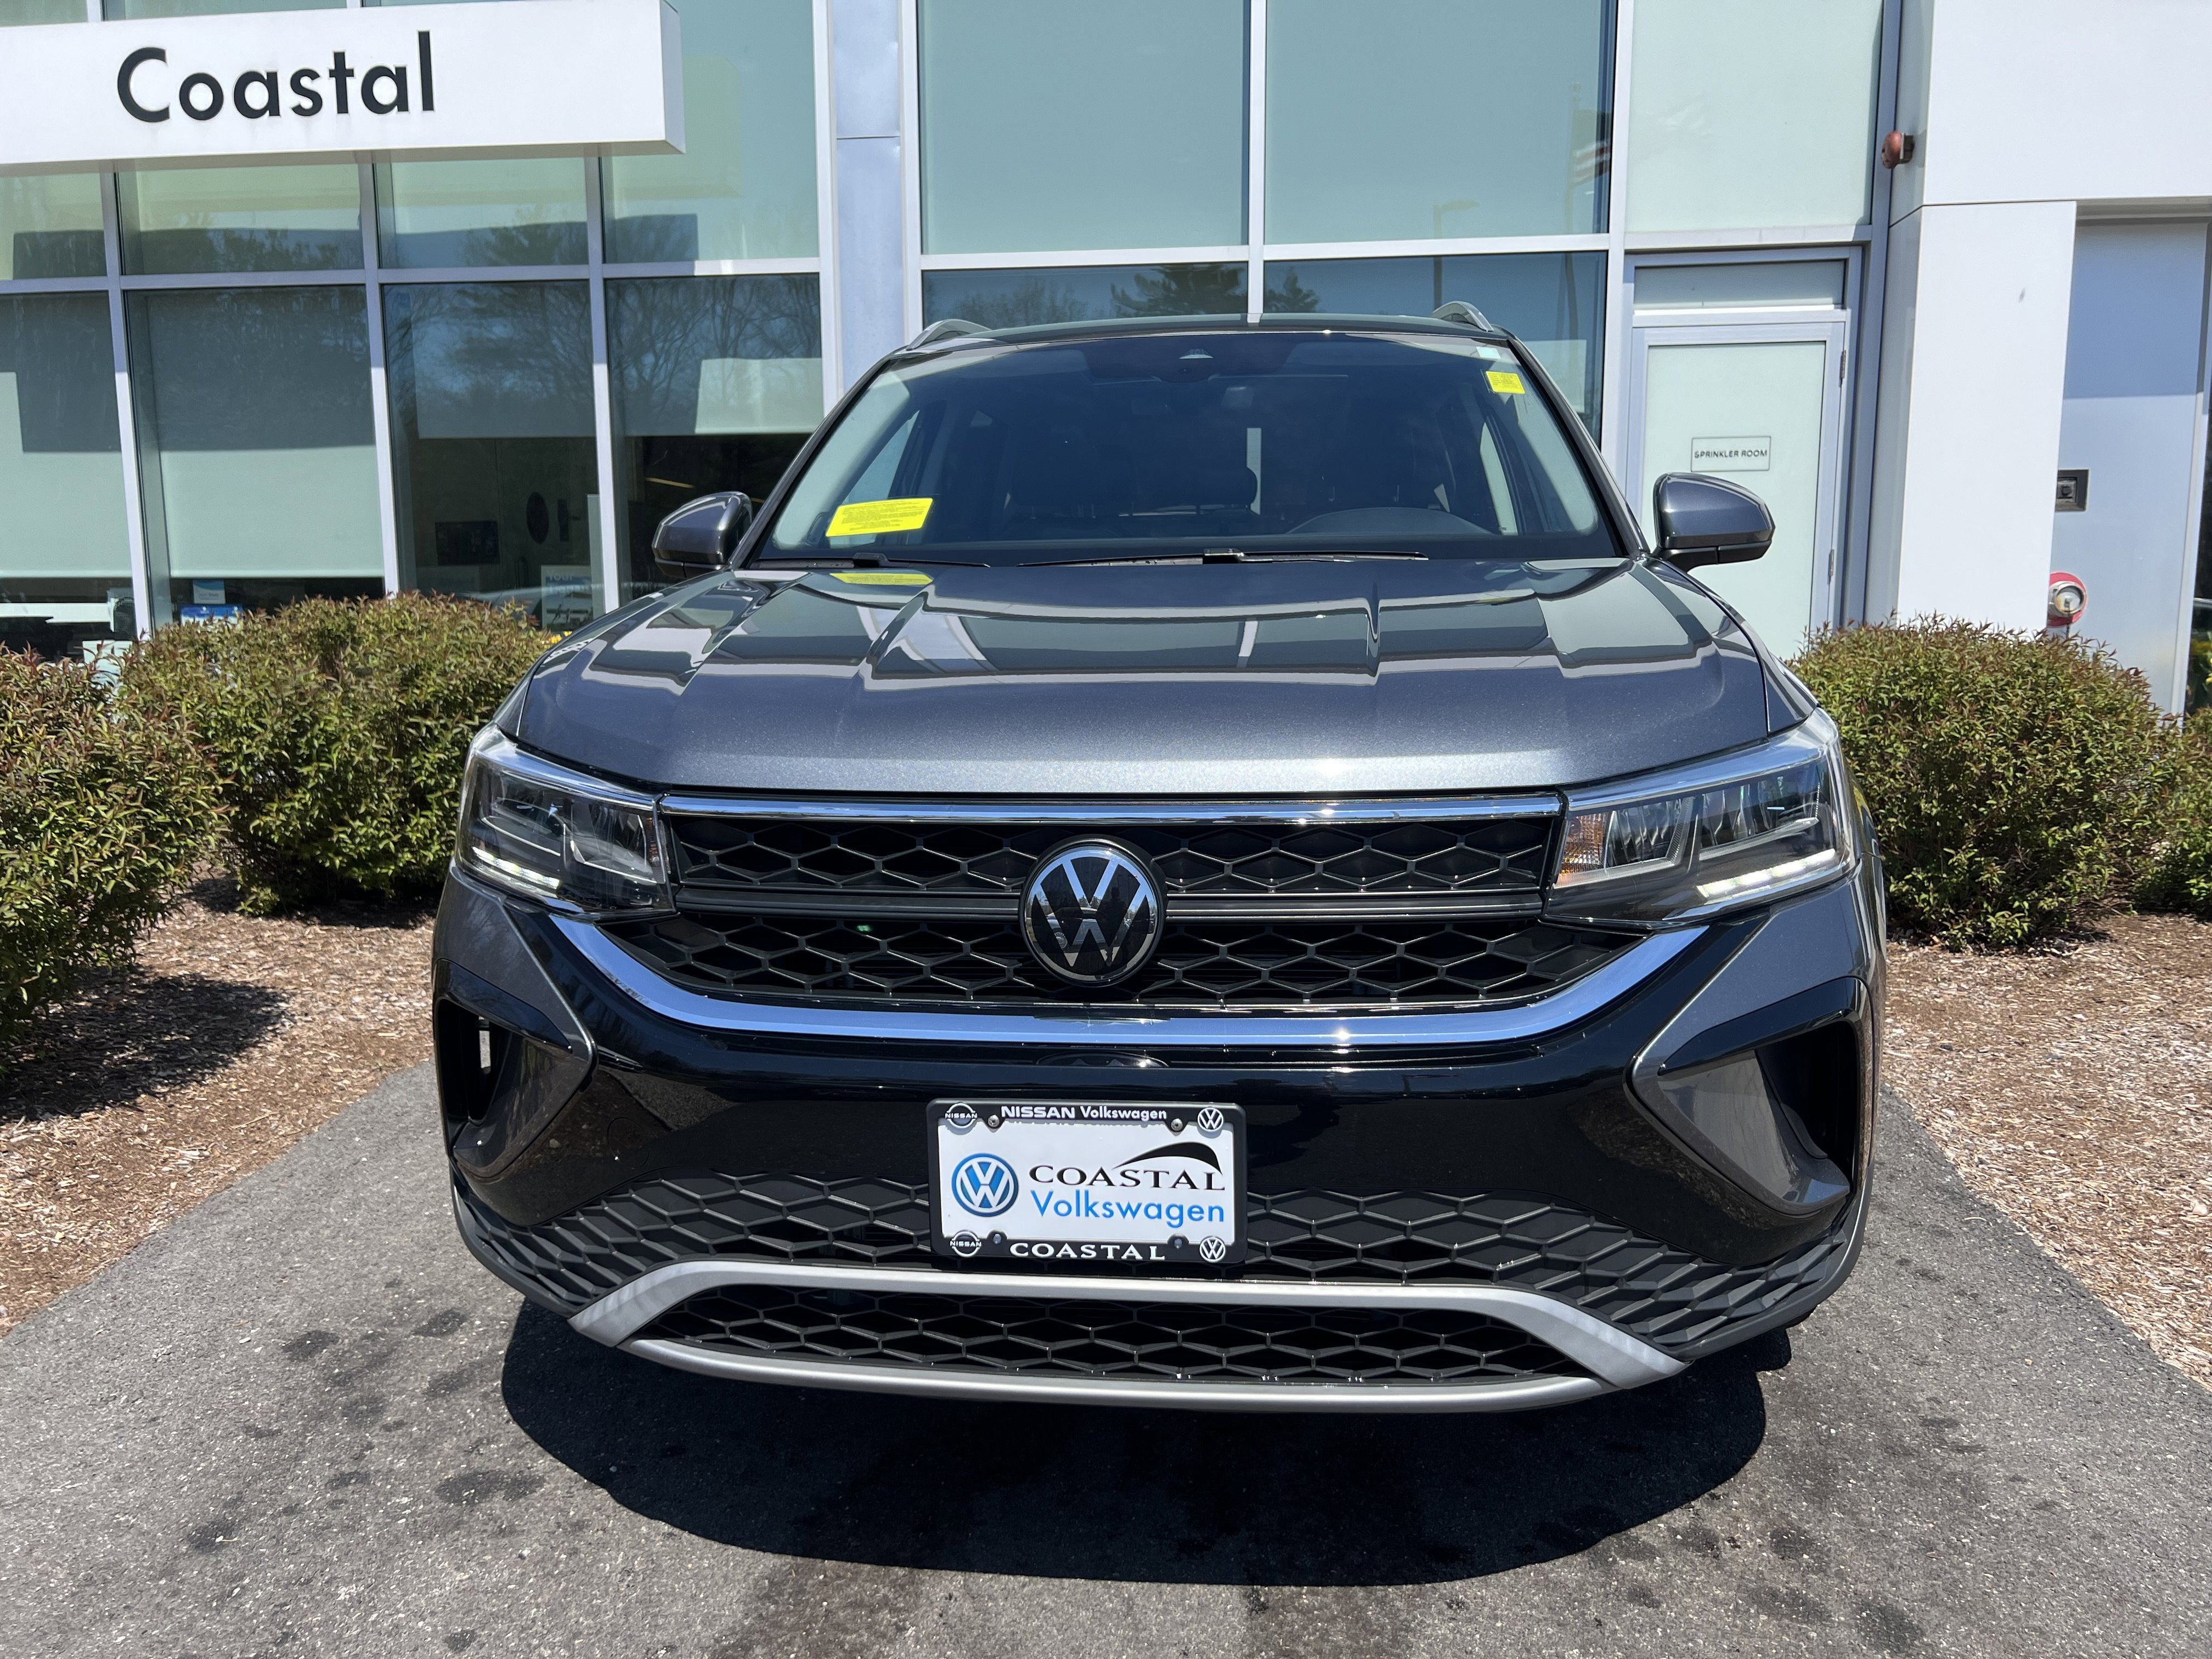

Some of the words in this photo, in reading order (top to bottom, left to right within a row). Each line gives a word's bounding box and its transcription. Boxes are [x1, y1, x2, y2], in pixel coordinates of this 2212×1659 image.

[117, 30, 435, 123] Coastal
[1001, 1106, 1075, 1118] NISSAN
[1080, 1106, 1167, 1121] Volkswagen
[1029, 1165, 1225, 1190] COASTAL
[1030, 1189, 1224, 1228] Volkswagen
[1010, 1243, 1165, 1261] COASTAL
